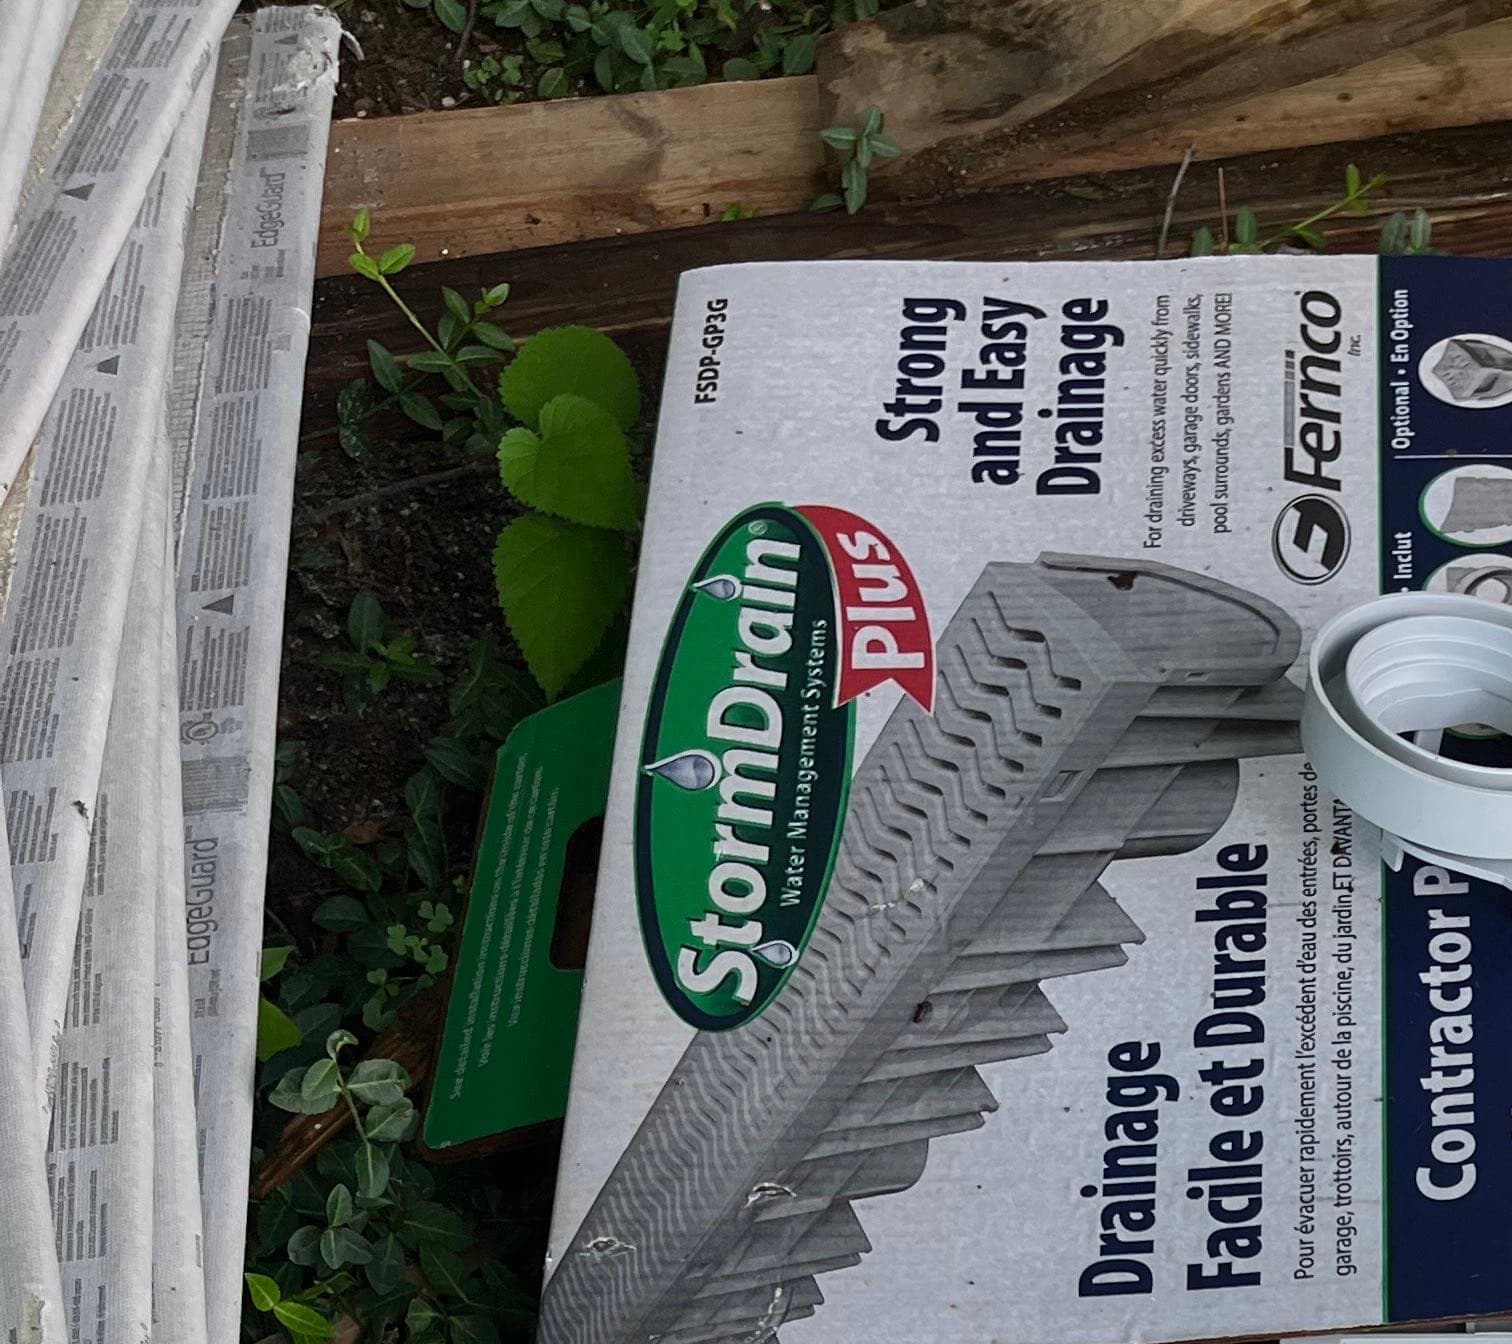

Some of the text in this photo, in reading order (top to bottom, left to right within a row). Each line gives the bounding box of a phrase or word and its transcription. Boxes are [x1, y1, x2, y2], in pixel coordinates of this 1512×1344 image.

[694, 297, 729, 404] FSDP-GP3G
[876, 298, 969, 442] Strong
[1347, 334, 1362, 356] Inc.
[1389, 290, 1415, 448] Optional En Option
[958, 296, 1047, 485] and Easy
[1032, 298, 1124, 495] Drainage
[1142, 294, 1174, 548] For draining excess water quickly from
[1175, 293, 1203, 527] driveways, garage doors, sidewalks,
[1208, 292, 1235, 534] pool surrounds, gardens AND MORE!
[1284, 291, 1341, 492] Fernco
[1392, 532, 1412, 578] Inclut
[835, 528, 926, 671] Plus
[675, 536, 802, 1004] StormDrain
[780, 620, 827, 906] Water Management Systems
[1298, 783, 1323, 833] portes
[1296, 836, 1321, 897] entrées,
[1332, 871, 1353, 891] ET
[1295, 900, 1317, 928] des
[1295, 931, 1317, 974] d'eau
[1330, 942, 1352, 964] du
[1294, 976, 1316, 1058] l'excédent
[1331, 966, 1357, 1026] piscine,
[1413, 865, 1476, 1200] Contractor P
[1186, 841, 1268, 1290] Facile et Durable
[1331, 1030, 1352, 1045] la
[1331, 1048, 1352, 1070] de
[1293, 1062, 1320, 1162] rapidement
[1332, 1073, 1352, 1130] autour
[1079, 1041, 1179, 1297] Drainage
[1292, 1165, 1315, 1234] évacuer
[1331, 1133, 1355, 1208] trottoirs,
[1293, 1238, 1315, 1279] Pour
[1335, 1210, 1357, 1276] garage,
